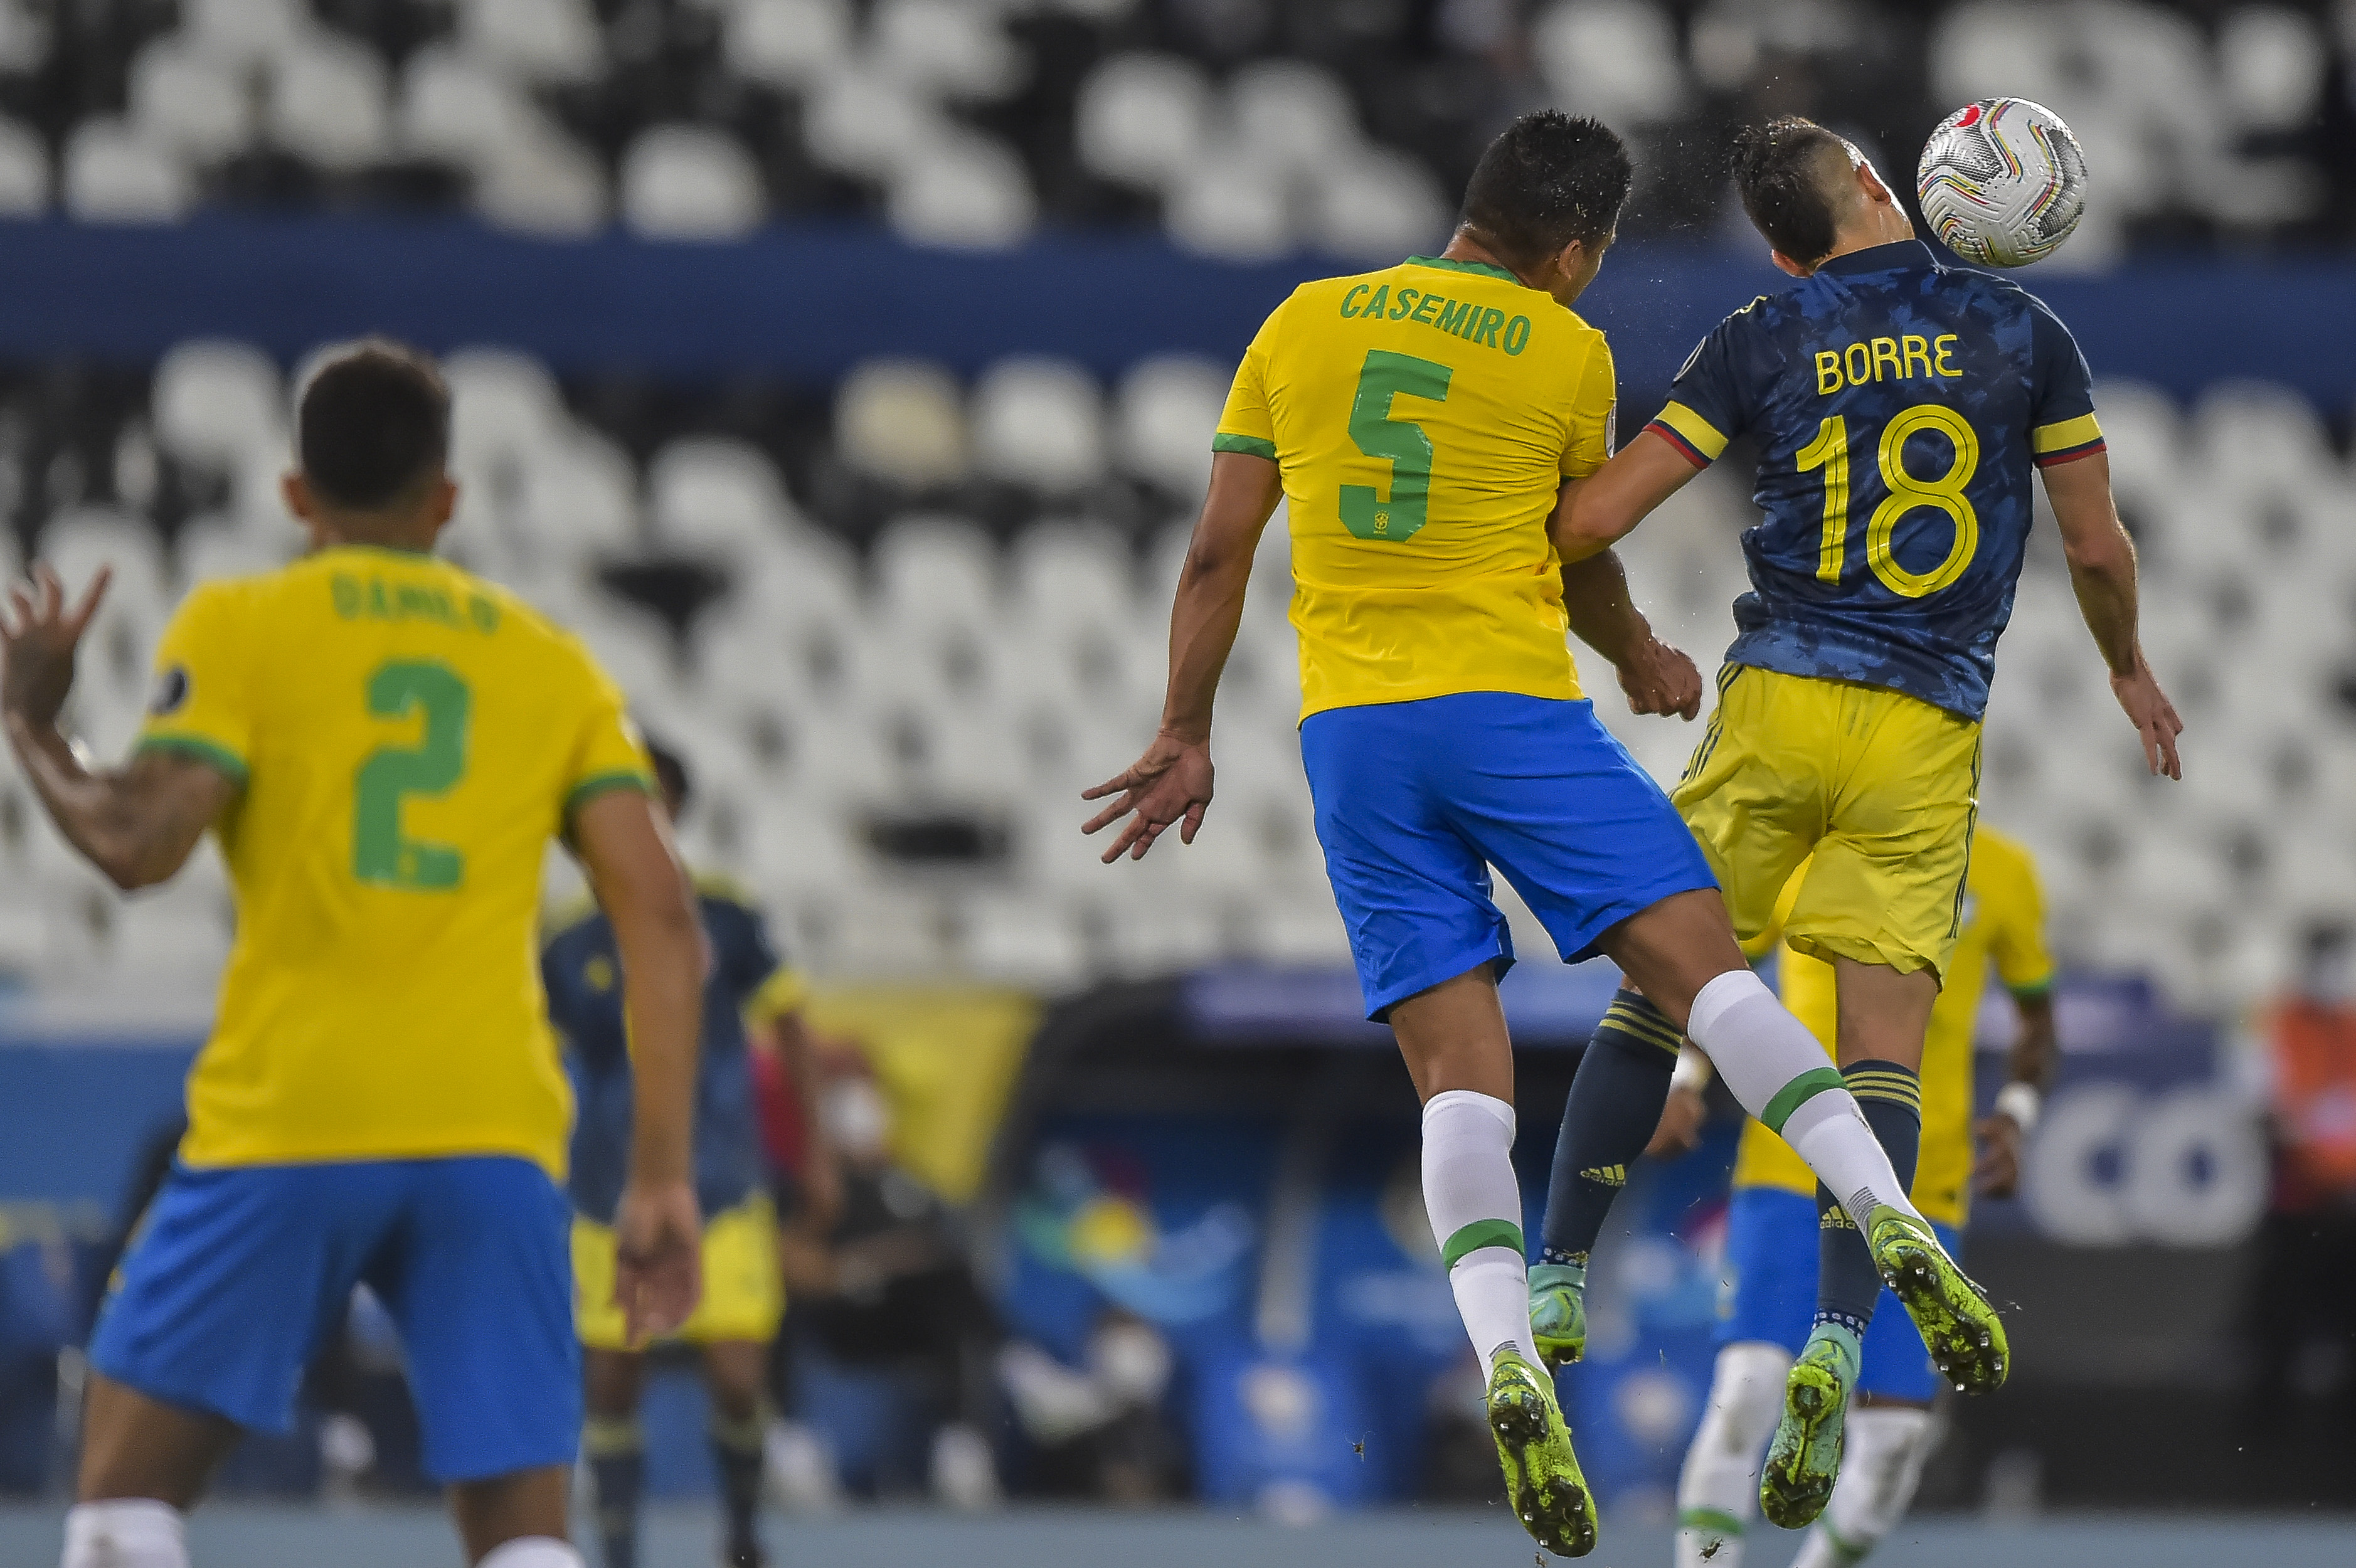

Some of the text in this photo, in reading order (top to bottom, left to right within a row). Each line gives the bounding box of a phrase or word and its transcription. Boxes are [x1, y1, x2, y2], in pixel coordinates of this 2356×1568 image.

[1339, 283, 1531, 357] CASEMIRO
[1815, 334, 1963, 395] BORRE
[1338, 349, 1453, 541] 5
[1795, 404, 1980, 598] 18
[353, 657, 470, 891] 2
